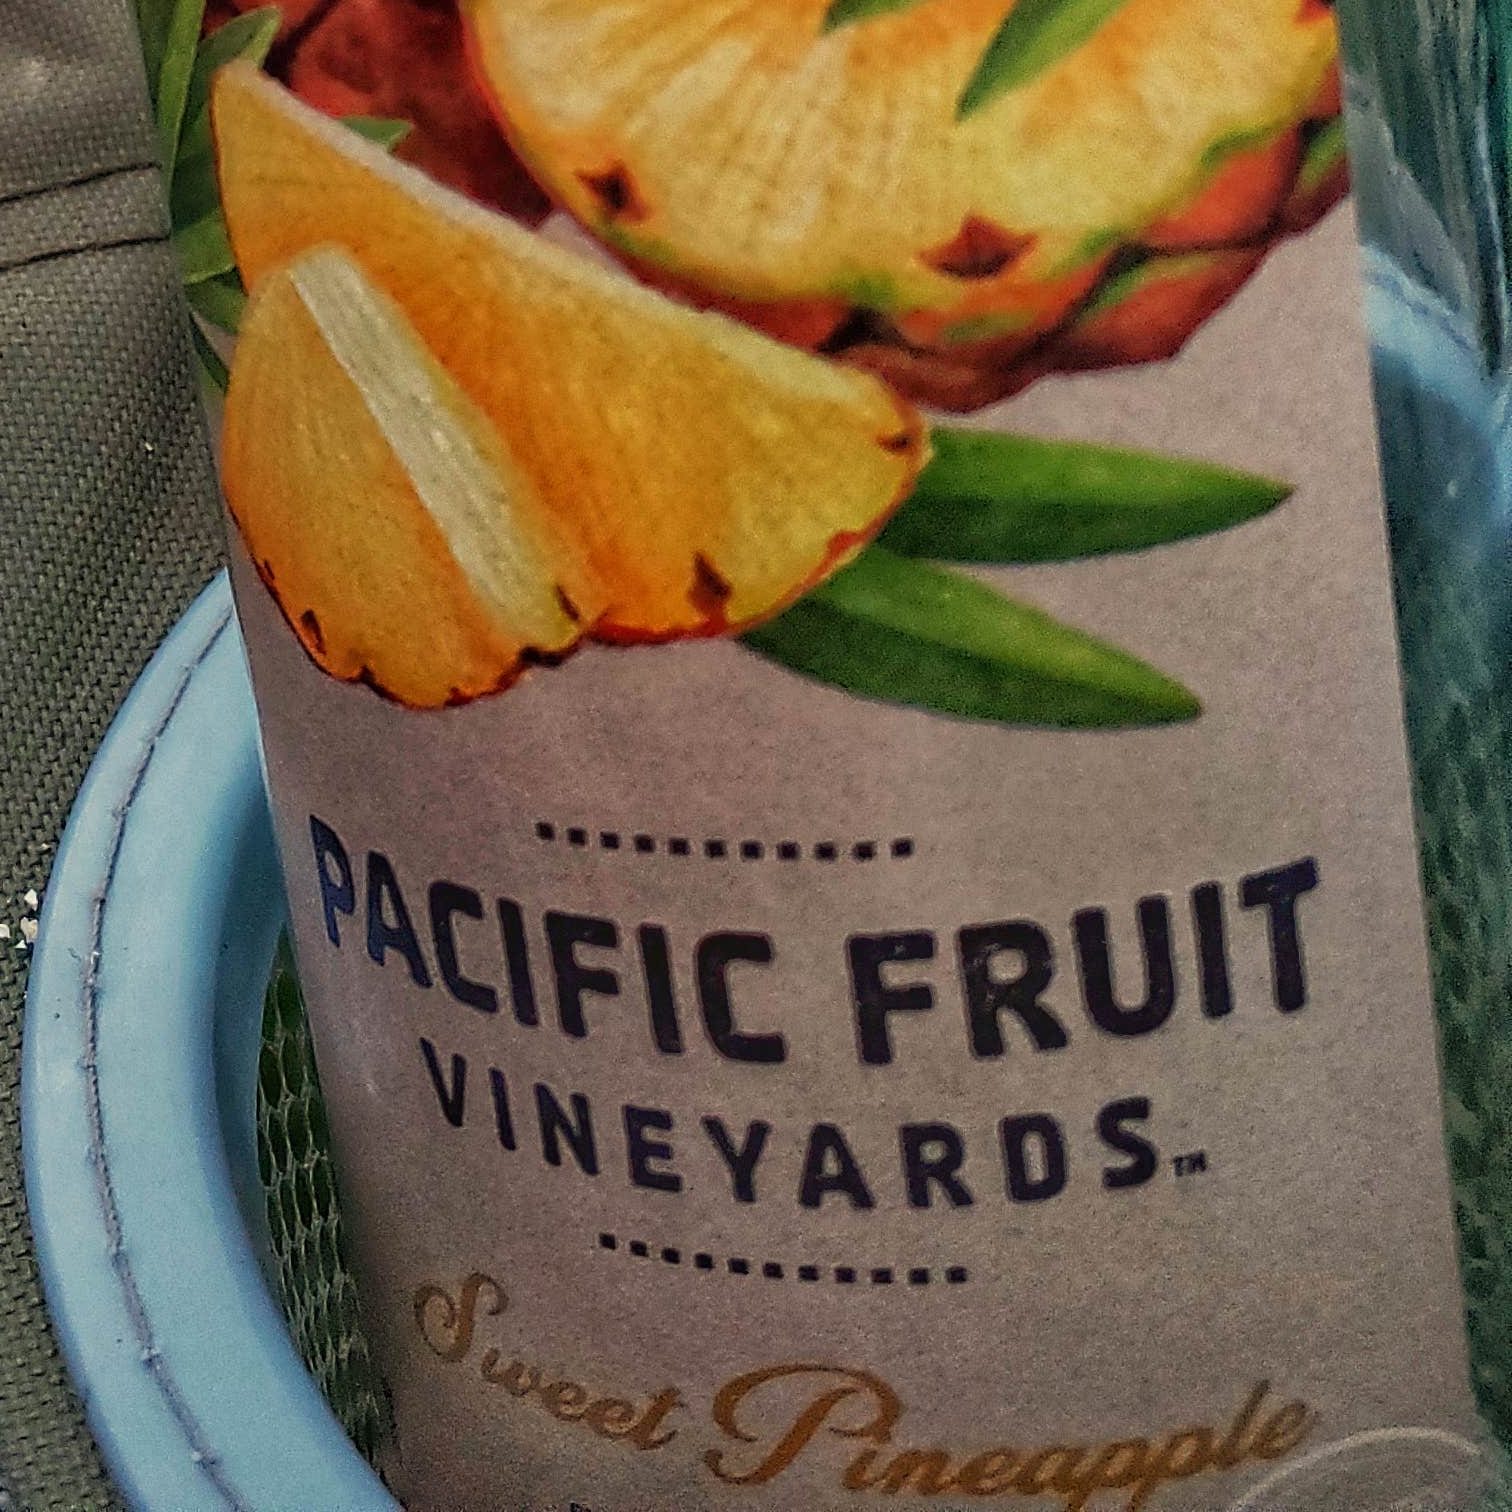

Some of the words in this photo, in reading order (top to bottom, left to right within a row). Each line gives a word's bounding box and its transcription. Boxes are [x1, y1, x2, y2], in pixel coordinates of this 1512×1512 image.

[308, 815, 789, 1063] PACIFIC
[845, 855, 1320, 1065] FRUIT
[419, 1037, 1158, 1210] VINEYARDS
[413, 1272, 689, 1452] Sweet
[703, 1362, 1320, 1512] Pineapple
